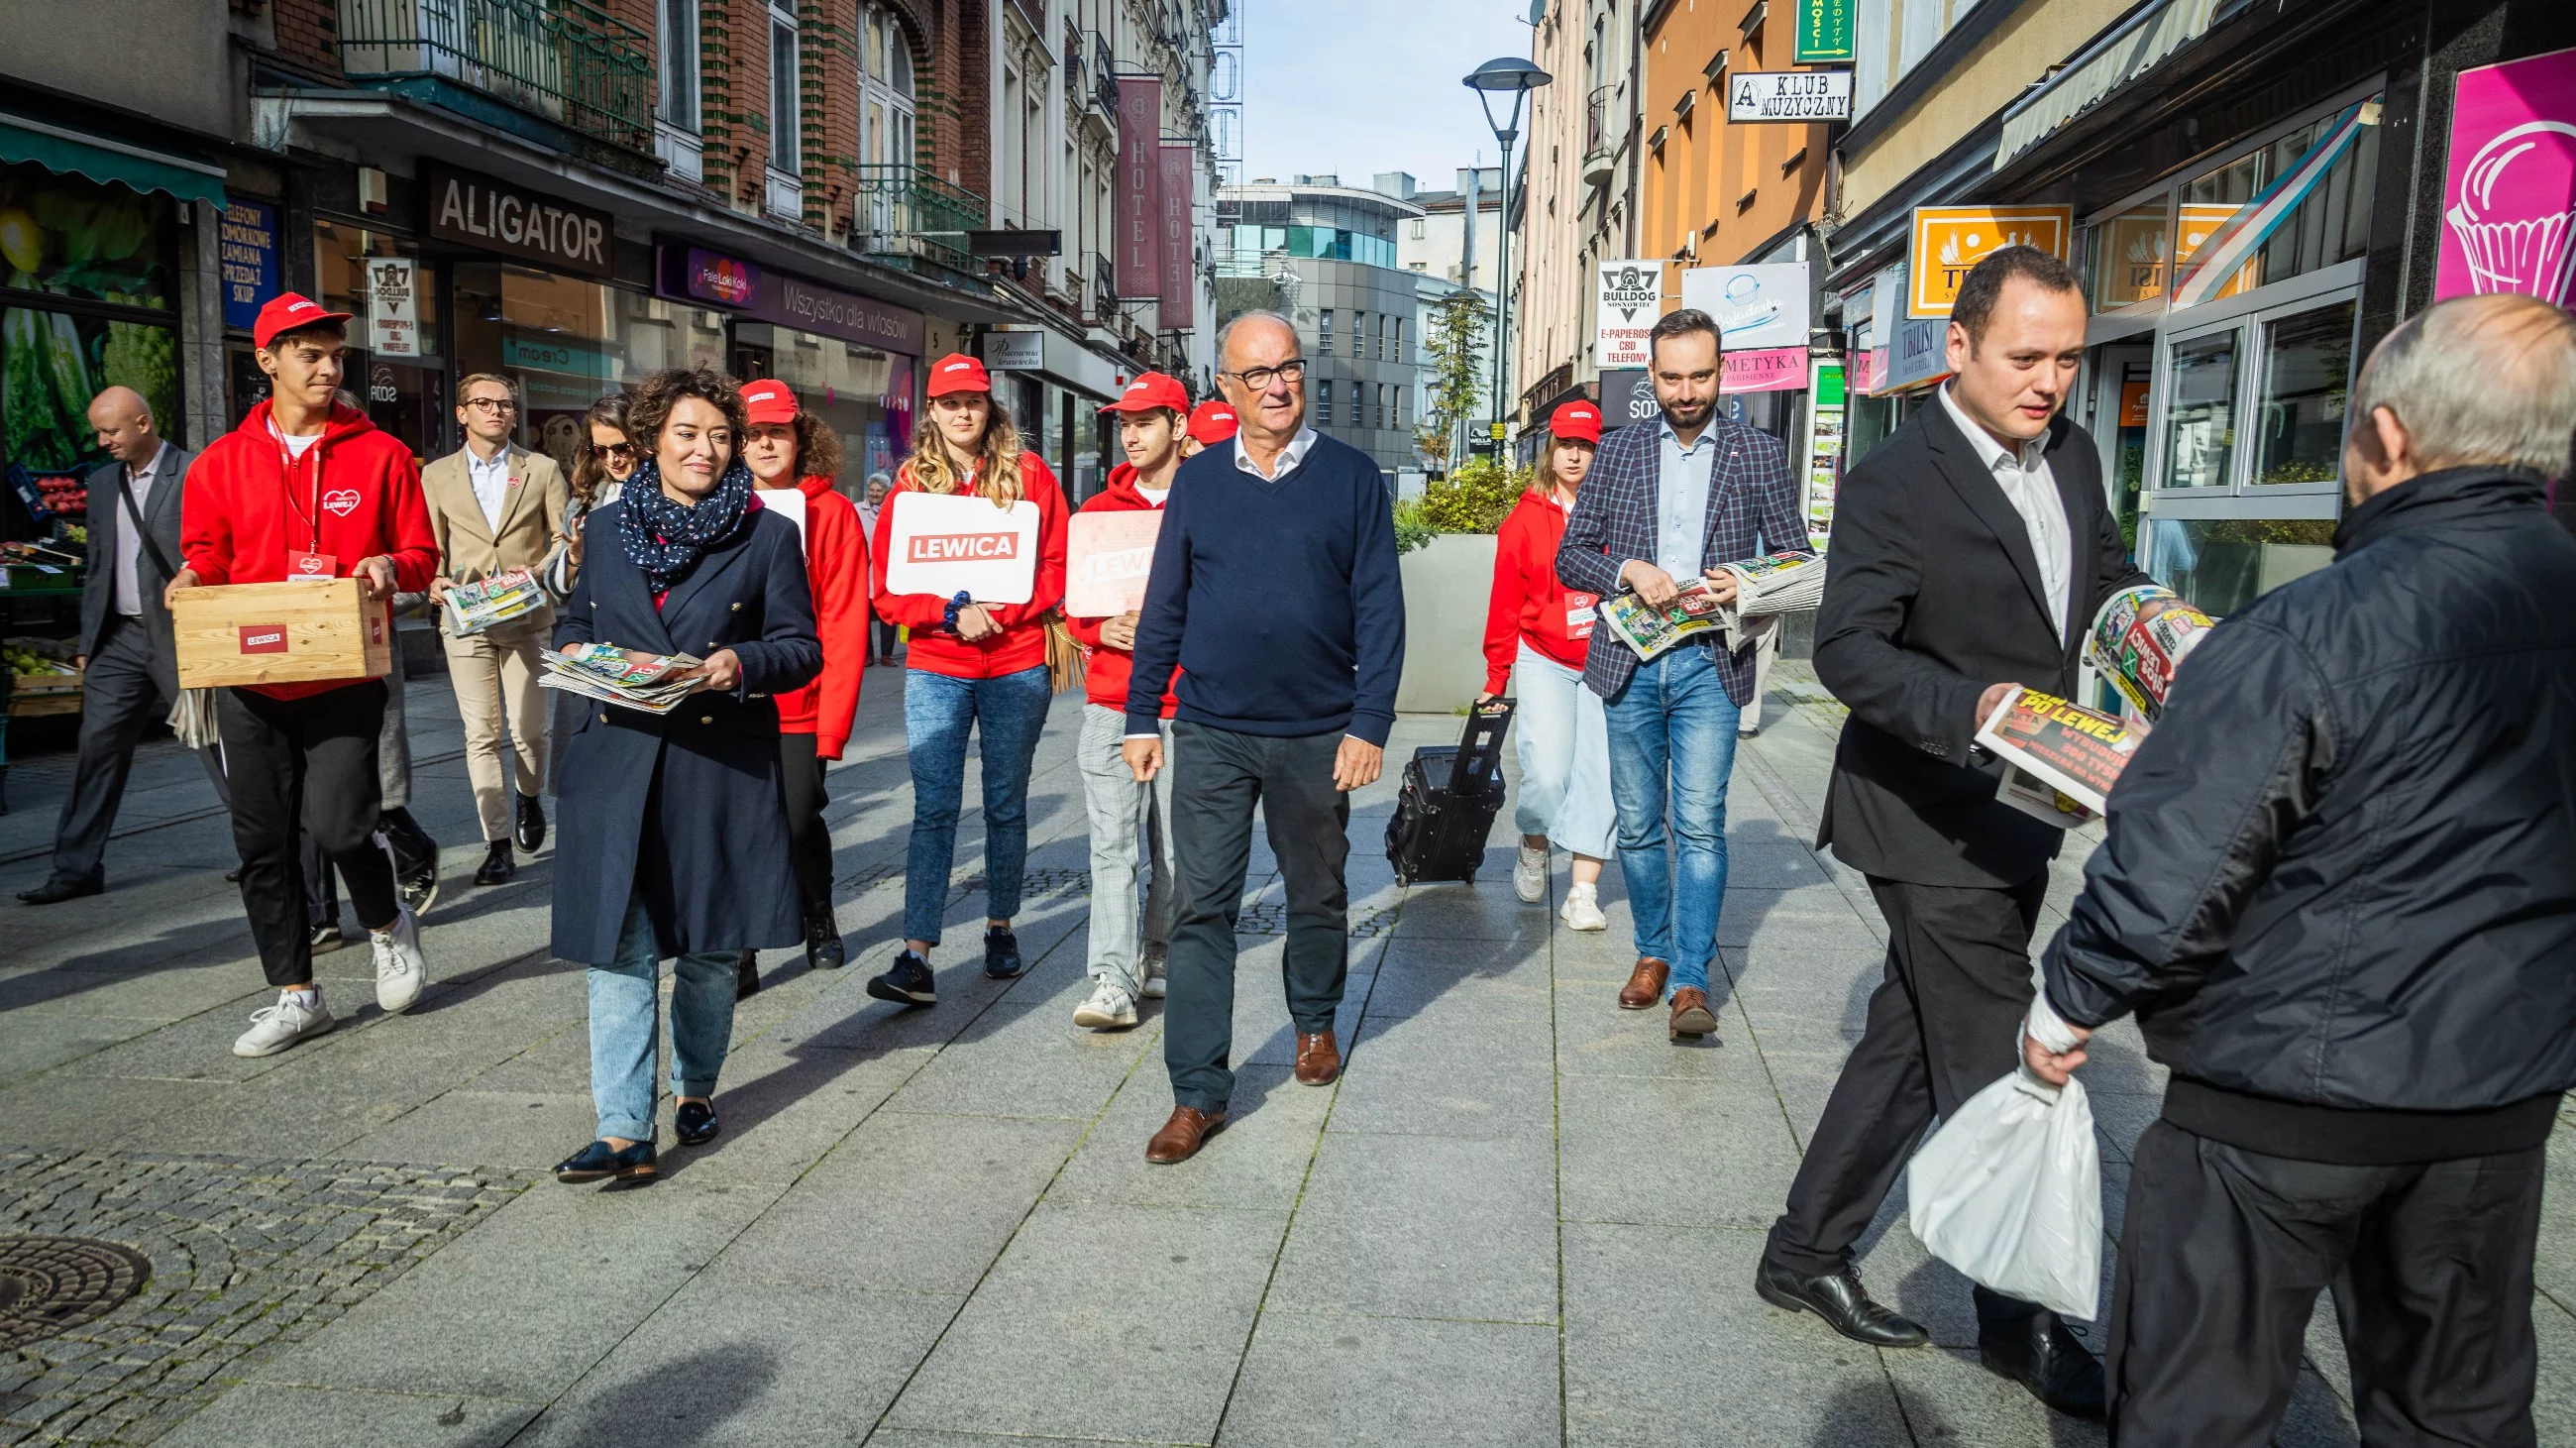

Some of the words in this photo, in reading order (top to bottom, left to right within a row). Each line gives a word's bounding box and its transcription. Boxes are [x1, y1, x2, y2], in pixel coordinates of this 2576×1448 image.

[1775, 75, 1829, 96] KLUB
[1760, 96, 1847, 117] MUZYCZNY
[1131, 142, 1145, 268] HOTEL
[439, 178, 603, 266] ALIGATOR
[221, 222, 272, 250] OMÓRKOWE
[221, 242, 263, 267] ZAMIANA
[233, 283, 256, 304] SKUP
[1603, 291, 1657, 301] BULLDOG
[784, 283, 843, 324] Wszystko
[846, 303, 865, 329] dla
[867, 310, 909, 340] włosów
[933, 332, 938, 348] 5
[1600, 328, 1653, 339] E-PAPIEROS
[1902, 320, 1933, 361] TBILISI
[989, 337, 1038, 358] Pracownia
[1619, 340, 1637, 351] CBD
[1607, 353, 1648, 363] TELEFONY
[1725, 355, 1799, 373] METYKA
[1629, 399, 1662, 419] SOJ
[323, 501, 354, 509] LEWEJ
[912, 536, 1014, 559] LEWICA
[2126, 627, 2160, 673] LEWICY
[2140, 660, 2164, 694] głos
[2018, 693, 2054, 715] PO
[2049, 707, 2128, 744] LEWEJ
